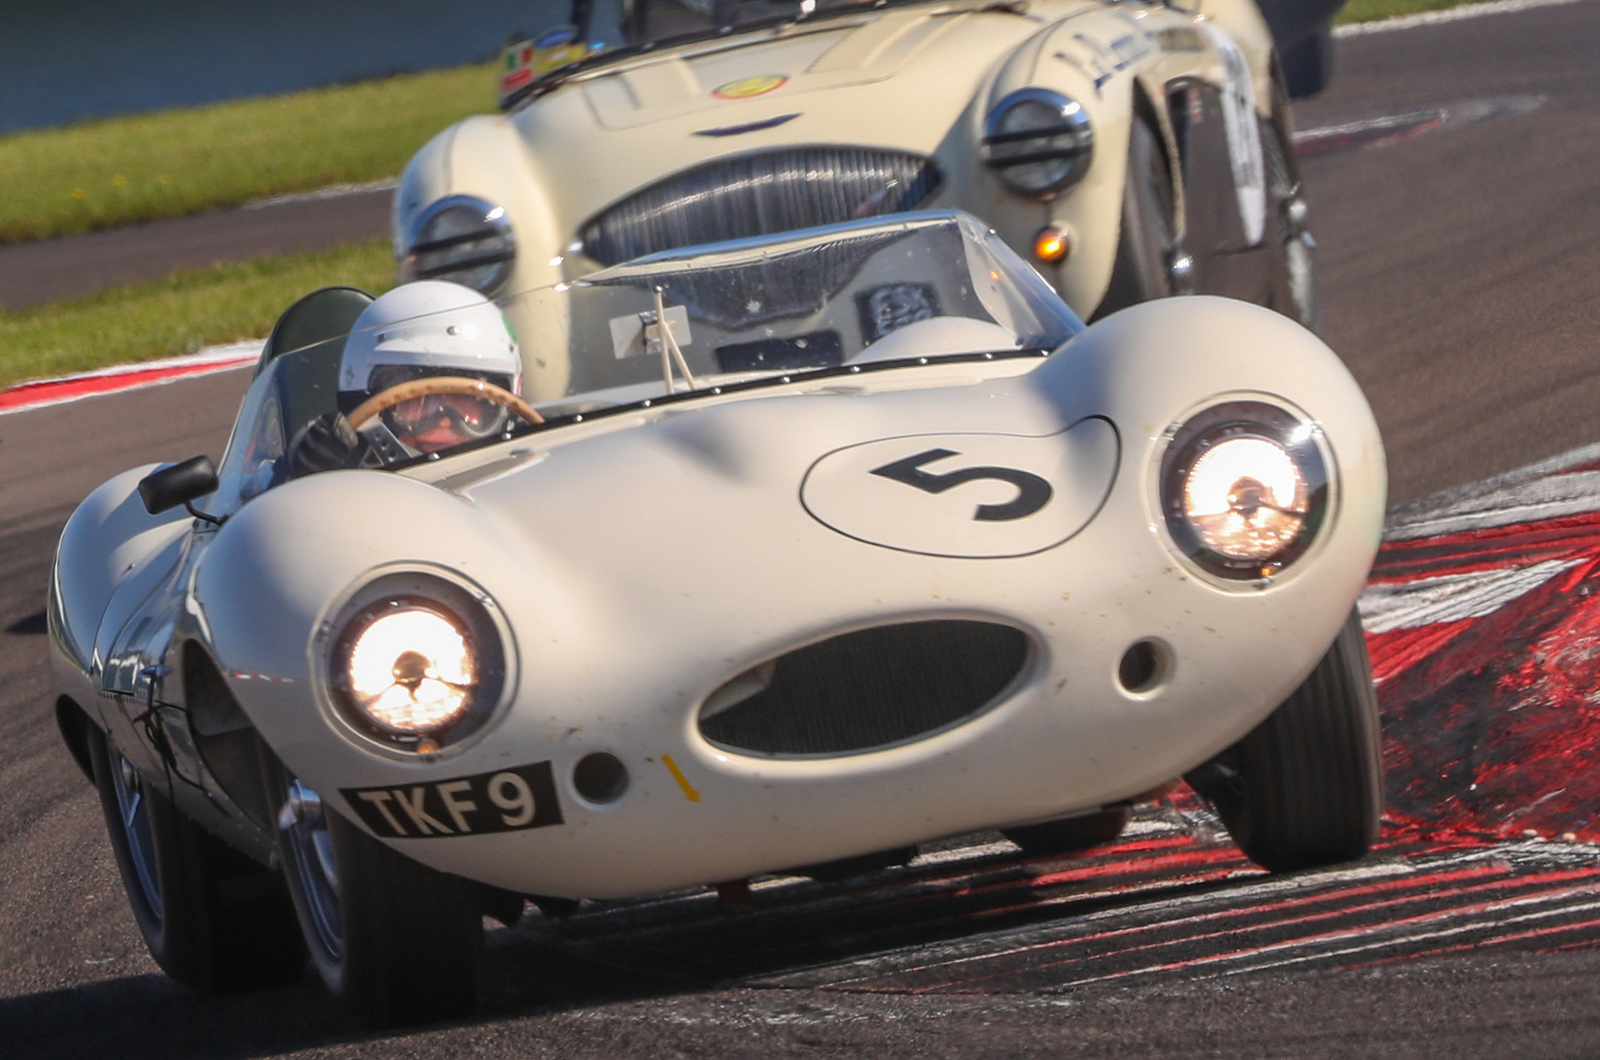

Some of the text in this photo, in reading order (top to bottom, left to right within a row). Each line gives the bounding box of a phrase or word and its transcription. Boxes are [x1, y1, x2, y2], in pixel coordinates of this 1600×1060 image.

[869, 448, 1053, 522] 5
[357, 772, 536, 836] TKF 9
